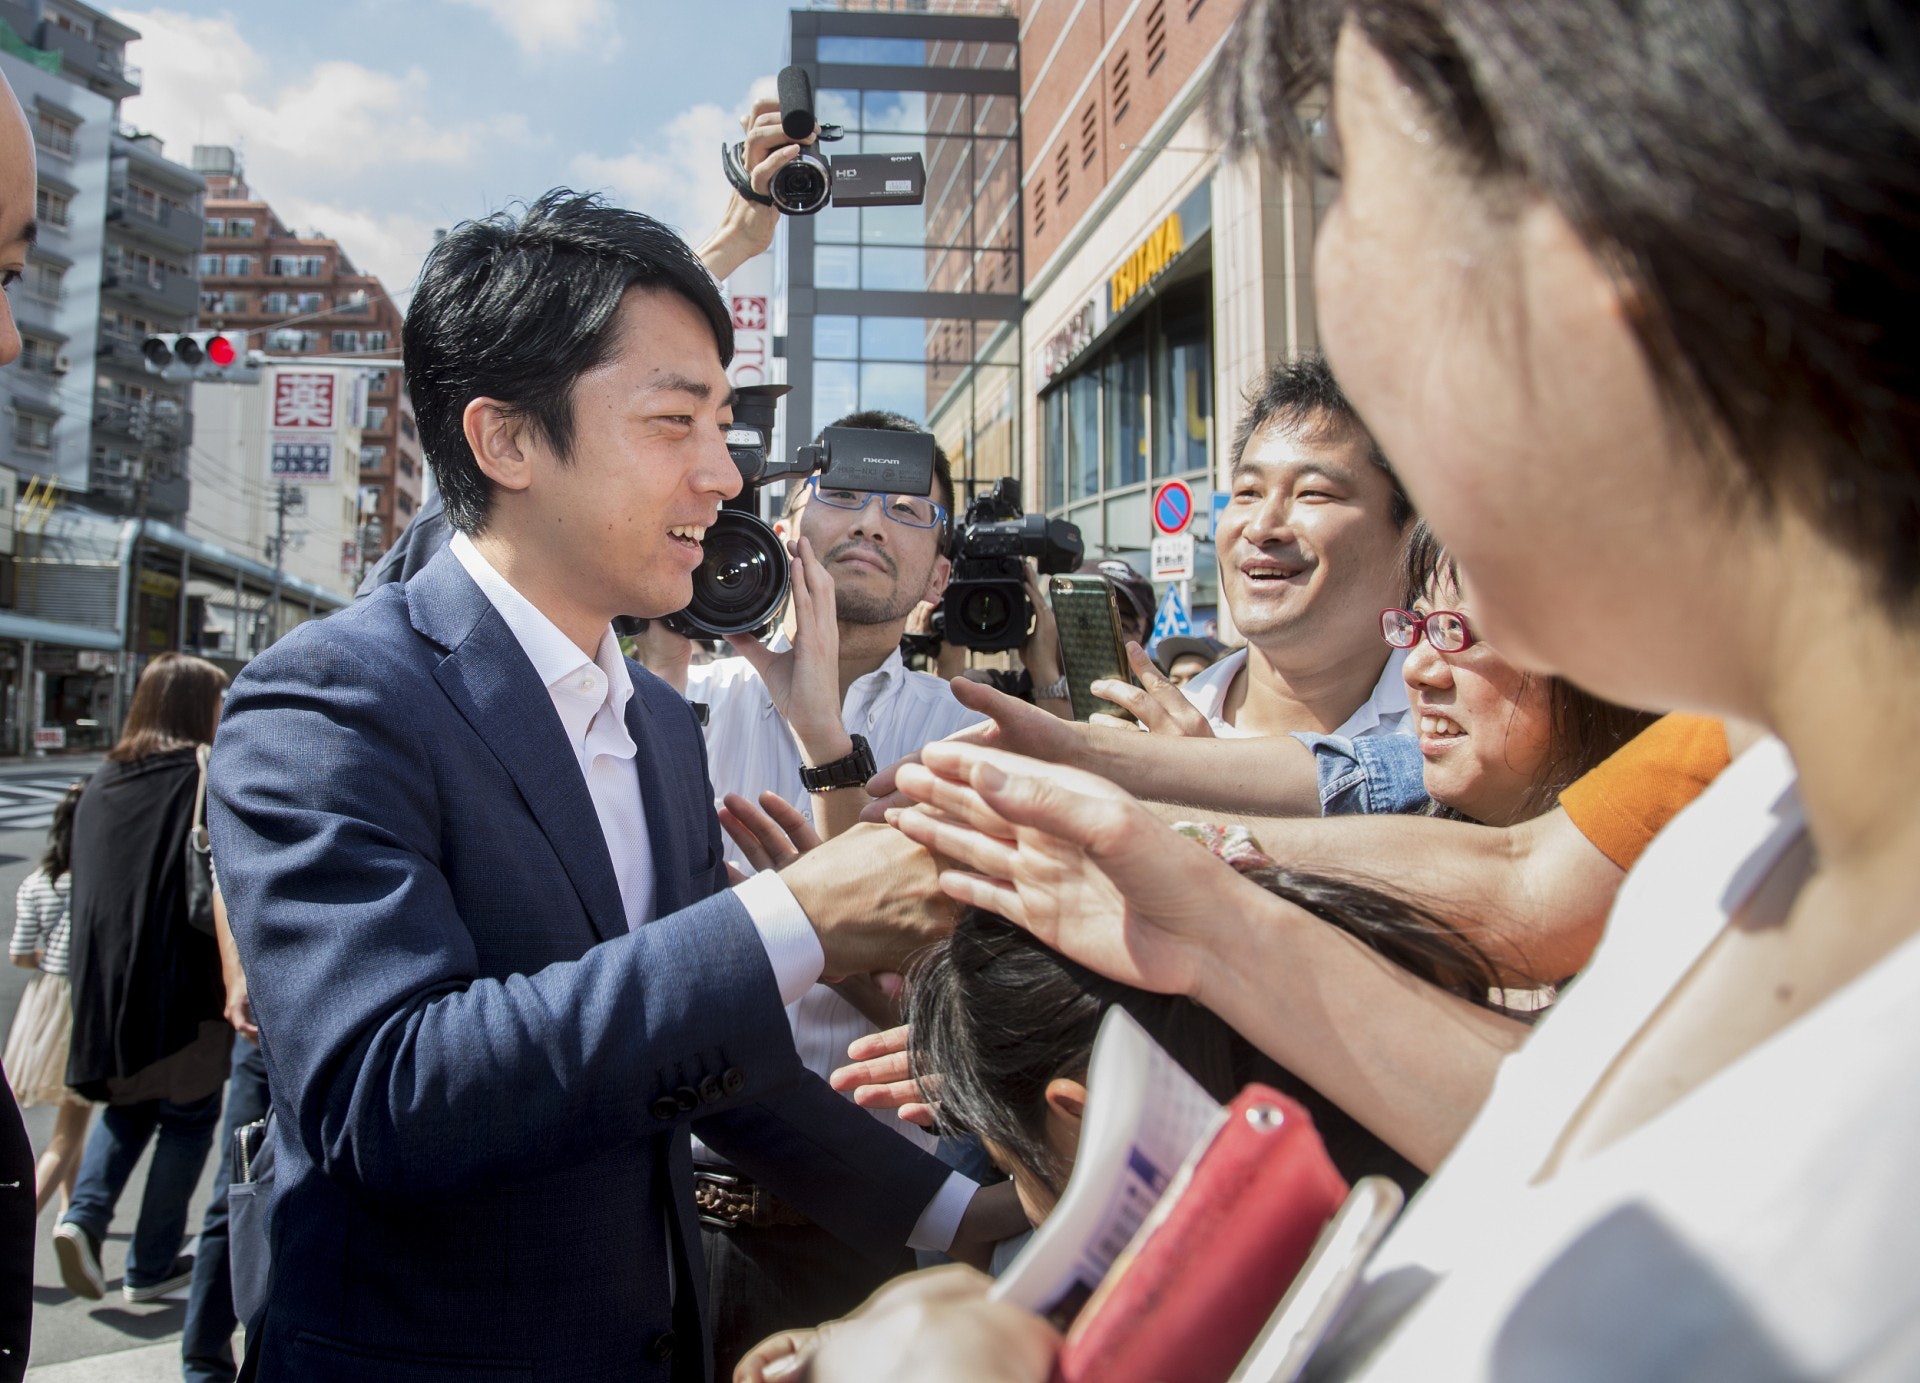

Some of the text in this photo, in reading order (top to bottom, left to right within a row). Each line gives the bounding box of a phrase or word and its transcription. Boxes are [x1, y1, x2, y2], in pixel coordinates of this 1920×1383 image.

[836, 169, 857, 177] HD
[1111, 213, 1183, 313] TSUTAYA
[277, 376, 331, 426] 薬
